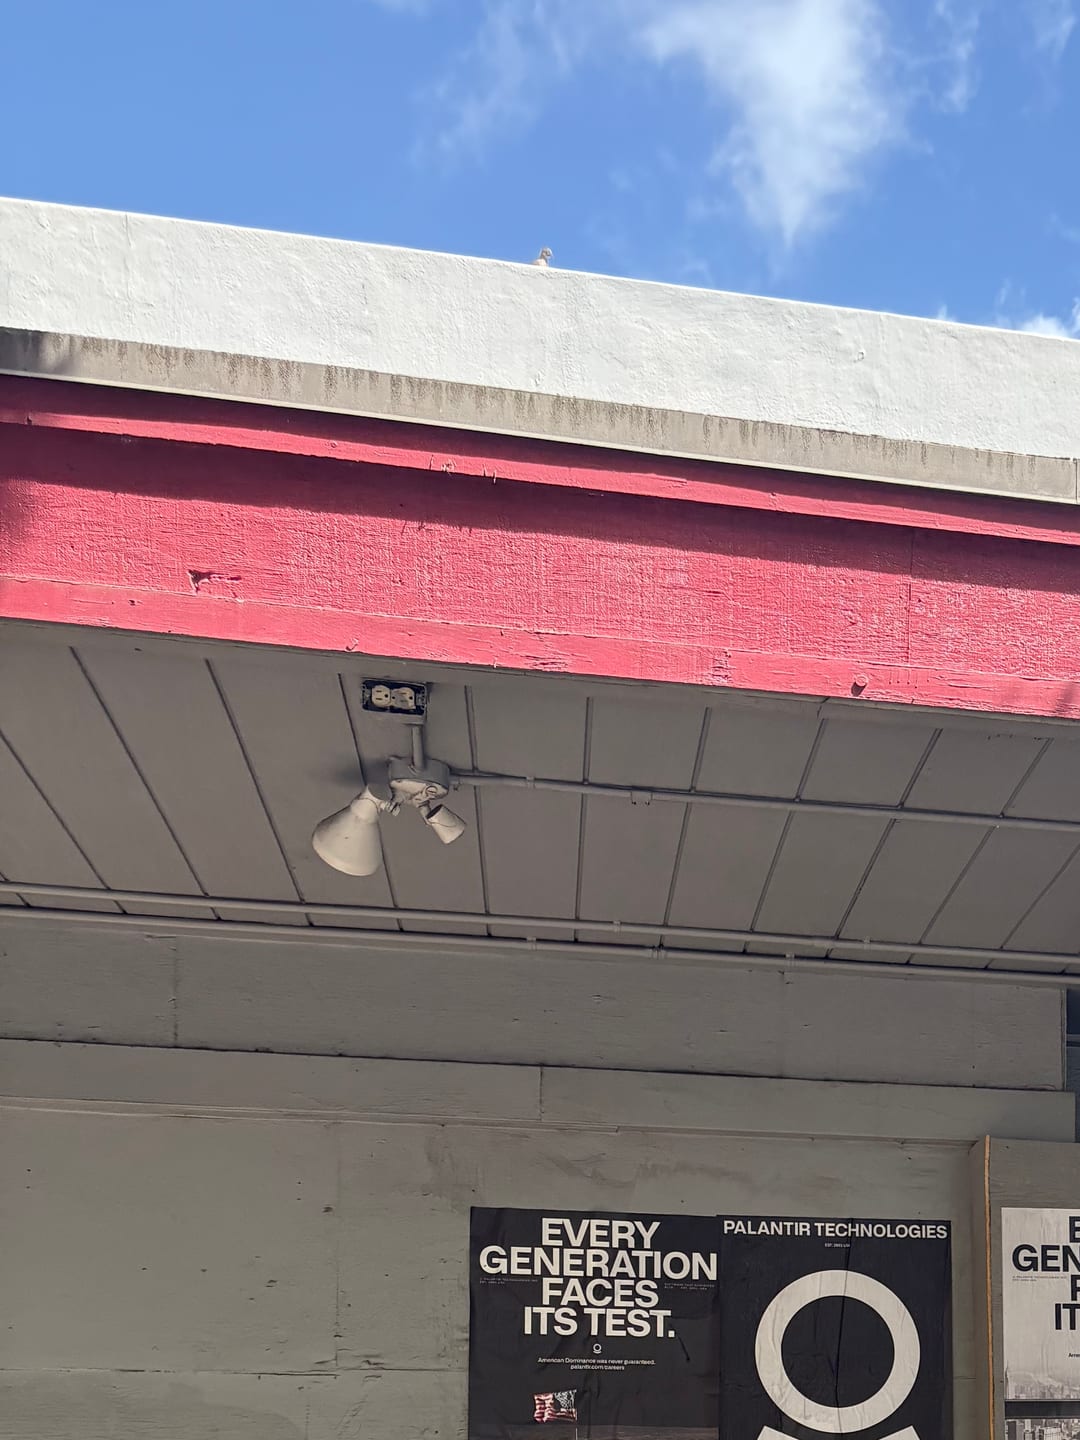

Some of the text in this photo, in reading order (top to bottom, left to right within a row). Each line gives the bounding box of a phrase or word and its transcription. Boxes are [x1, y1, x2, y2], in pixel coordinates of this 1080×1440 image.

[542, 1218, 660, 1248] EVERY
[724, 1220, 947, 1239] PALANTIR TECHNOLOGIES
[480, 1246, 717, 1280] GENERATION
[542, 1278, 658, 1307] FACES
[524, 1307, 675, 1337] ITS TEST.
